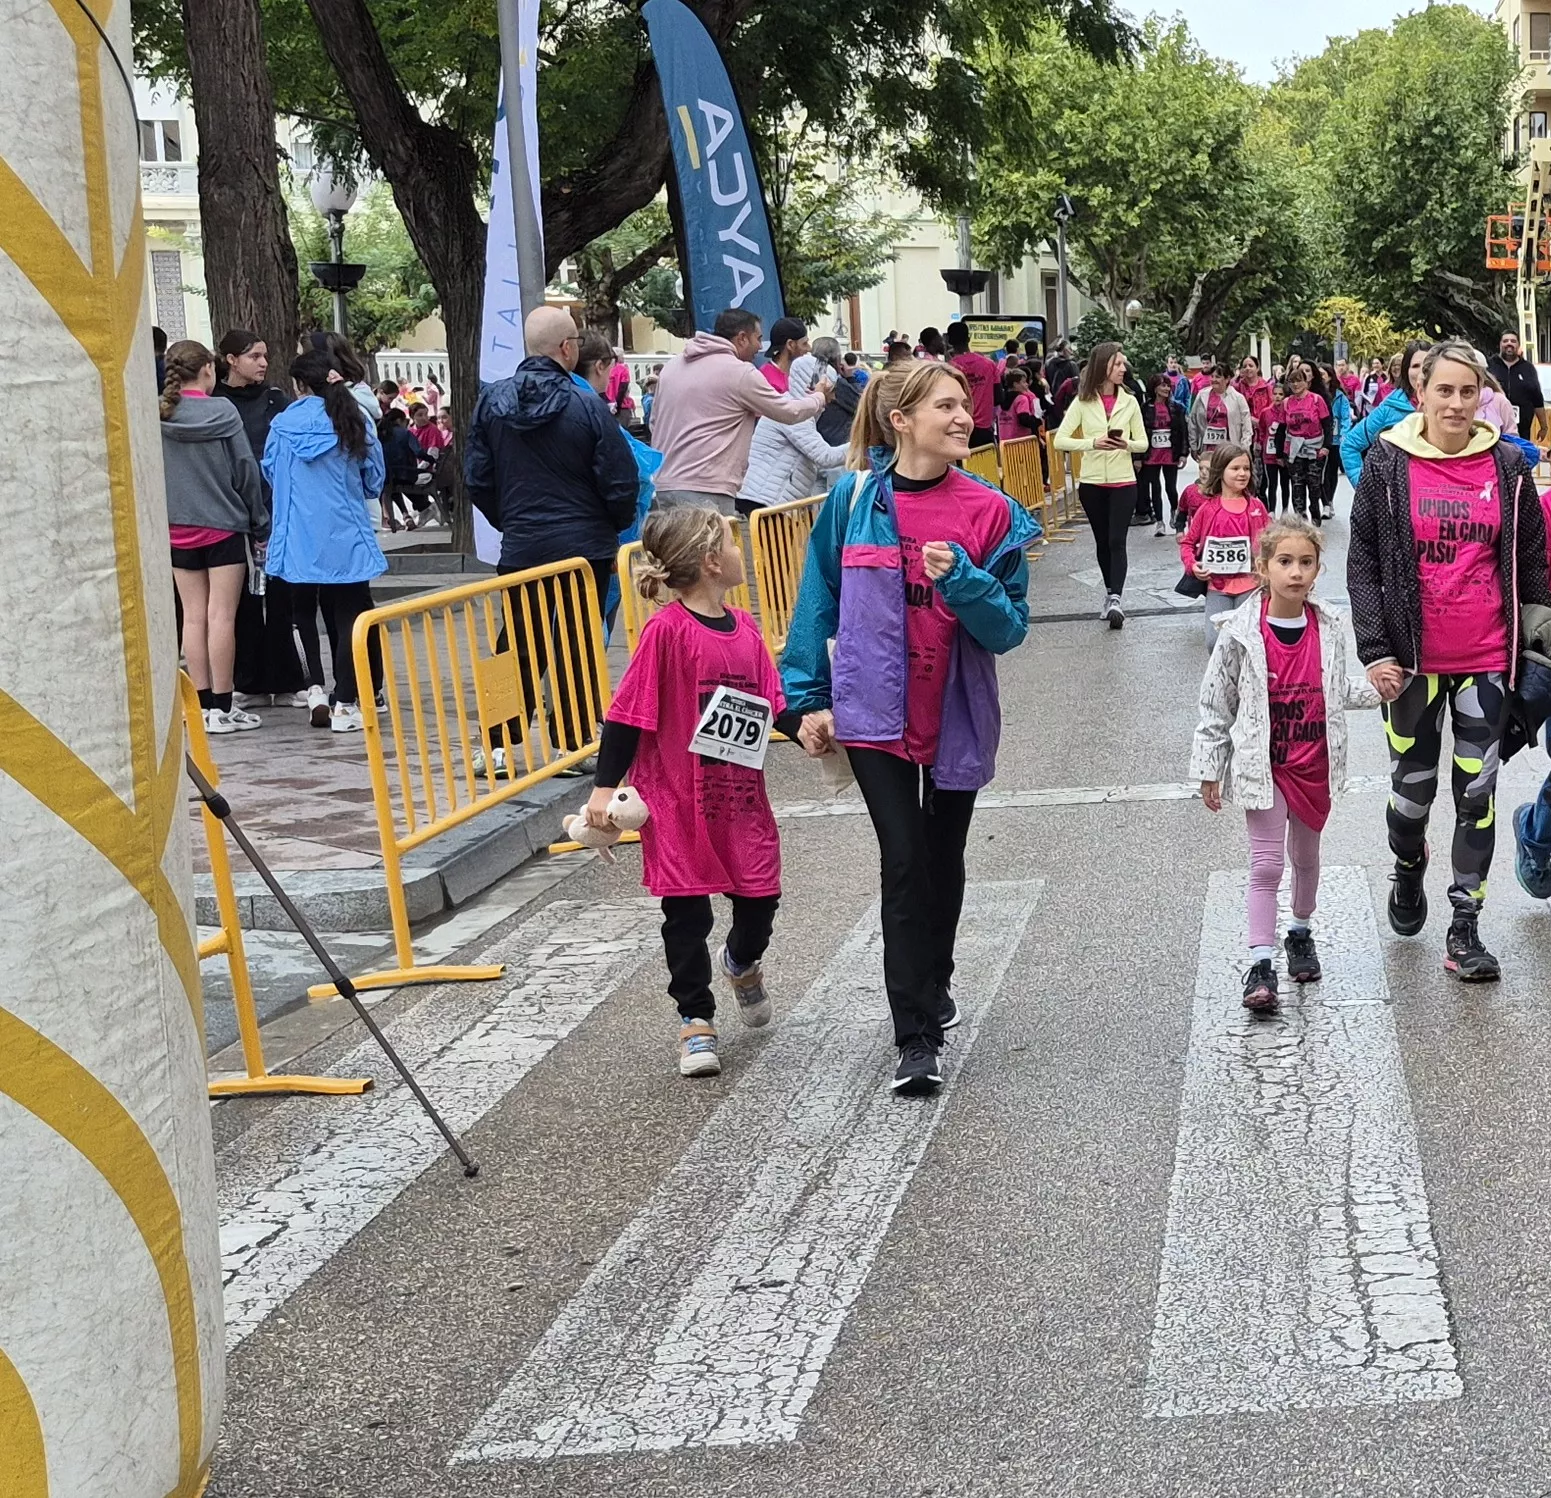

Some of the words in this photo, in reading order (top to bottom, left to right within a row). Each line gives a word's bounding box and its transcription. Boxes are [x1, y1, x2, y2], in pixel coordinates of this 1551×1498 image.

[1440, 520, 1456, 540] EN
[1207, 549, 1246, 563] 3586
[905, 582, 934, 609] ADA
[700, 710, 761, 746] 2079
[1270, 741, 1288, 765] SO
